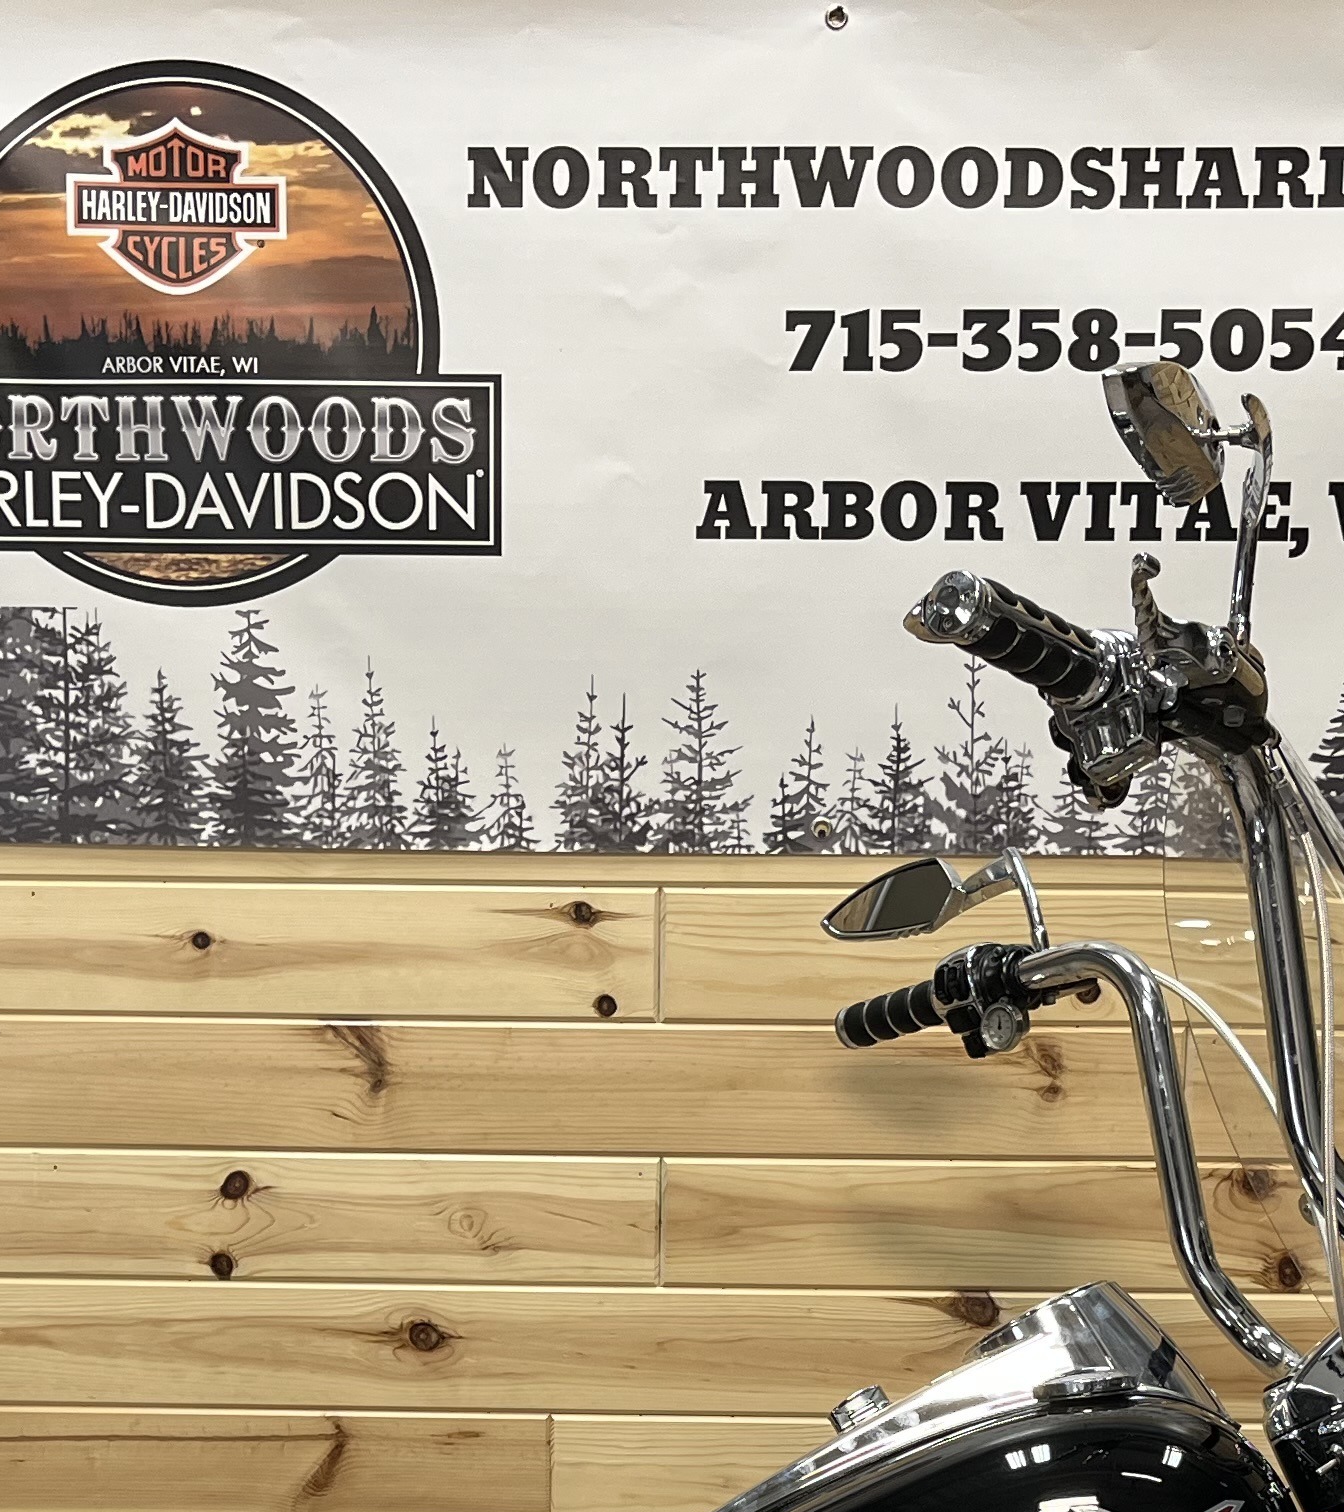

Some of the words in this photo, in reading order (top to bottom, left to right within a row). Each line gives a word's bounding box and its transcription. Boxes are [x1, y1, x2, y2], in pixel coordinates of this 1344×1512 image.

[127, 138, 227, 178] MOTOR
[82, 189, 271, 224] HARLEY-DAVIDSON
[127, 235, 227, 279] CYCLES
[102, 356, 163, 374] ARBOR
[169, 356, 226, 377] VITAE,
[232, 356, 259, 374] WI
[696, 481, 1004, 541] ARBOR
[1021, 481, 1309, 558] VITAE,
